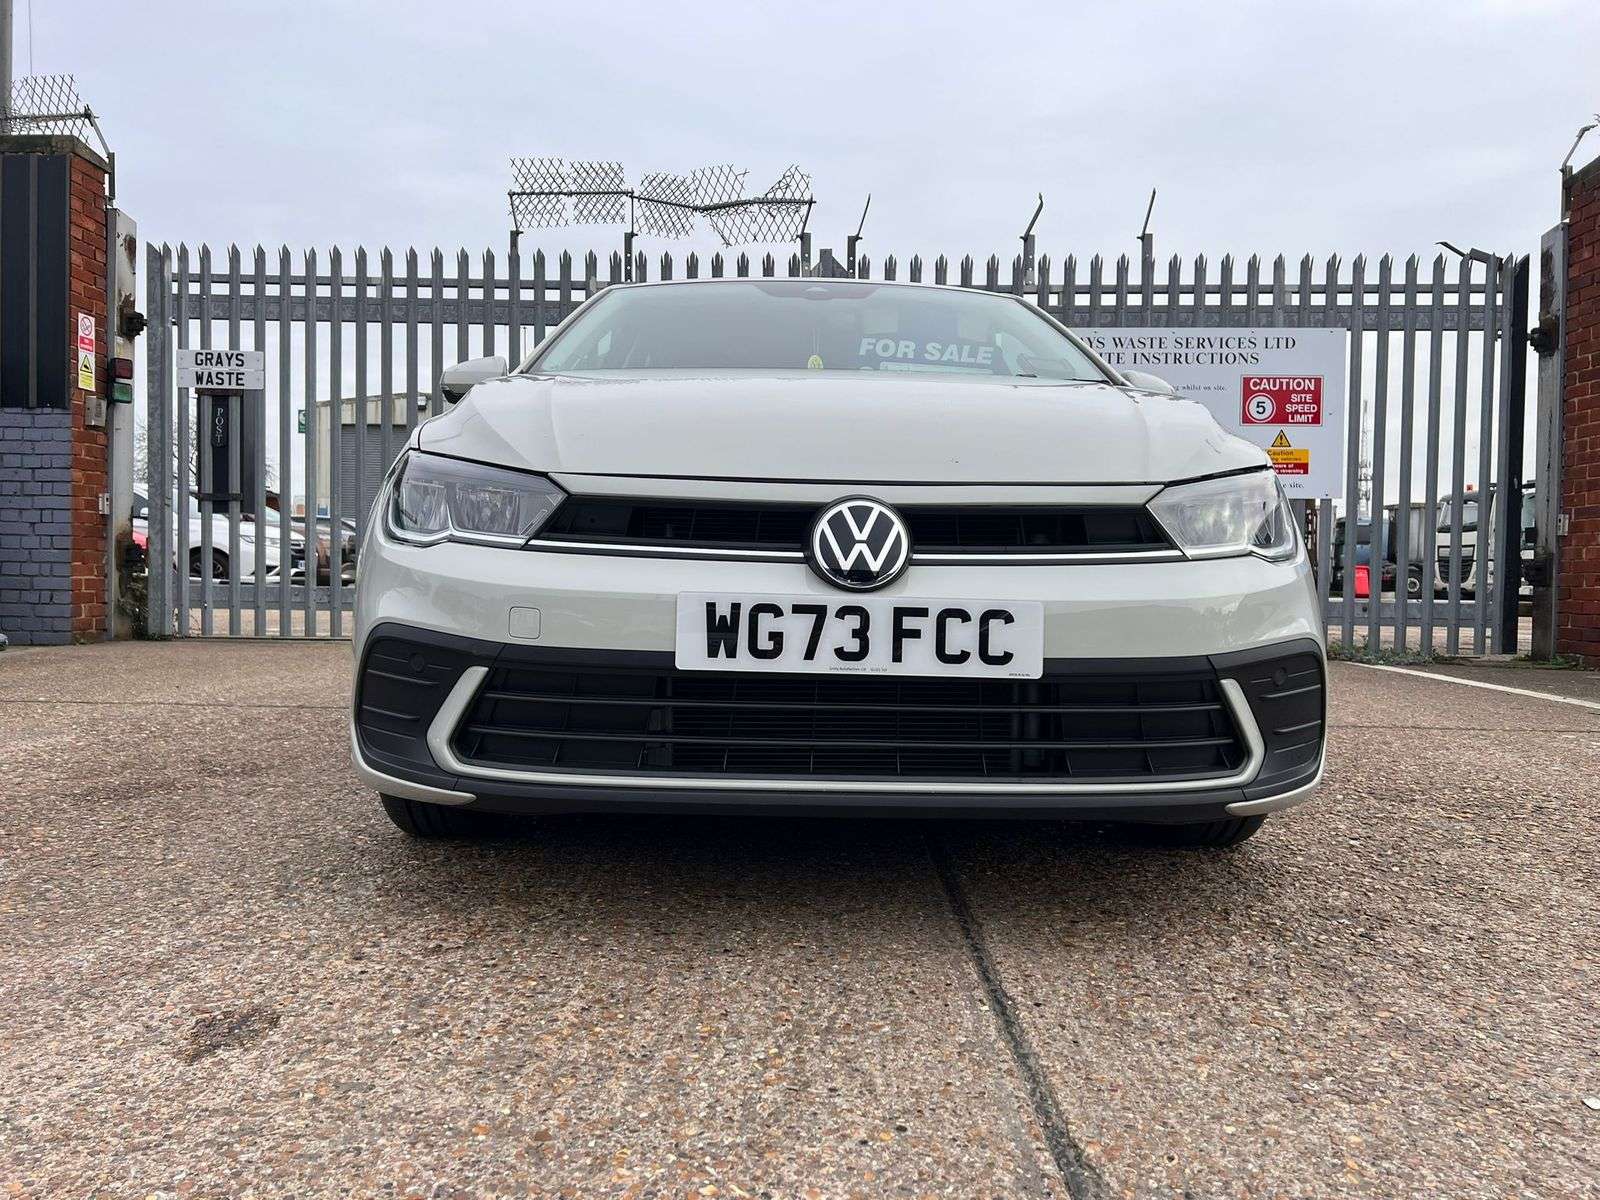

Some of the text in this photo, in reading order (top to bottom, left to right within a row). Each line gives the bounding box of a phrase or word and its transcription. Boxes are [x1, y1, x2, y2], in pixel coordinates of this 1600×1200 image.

[1112, 336, 1168, 349] WASTE
[1174, 336, 1257, 349] SERVICES
[1264, 336, 1296, 349] LTD
[858, 337, 994, 365] FOR SALE
[194, 352, 245, 367] GRAYS
[1133, 352, 1260, 365] INSTRUCTIONS
[195, 371, 245, 386] WASTE
[1249, 378, 1315, 391] CAUTION
[1290, 393, 1313, 403] SITE
[1255, 401, 1266, 415] 5
[1285, 403, 1318, 413] SPEED
[1288, 414, 1314, 423] LIMIT
[215, 407, 224, 444] POST
[705, 602, 1015, 666] WG73 FCC
